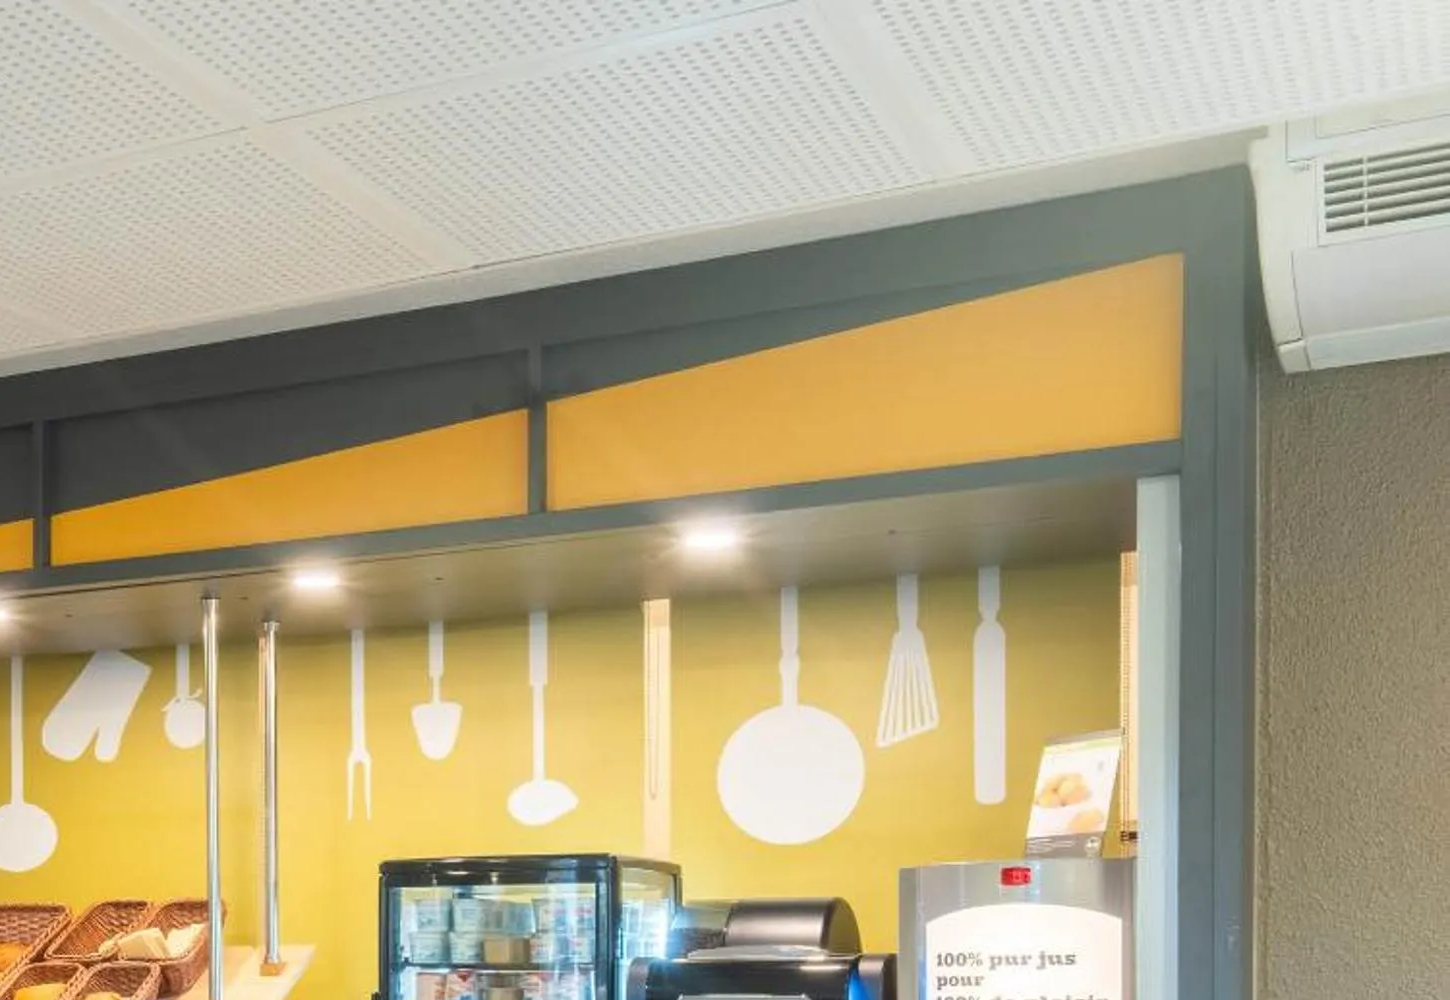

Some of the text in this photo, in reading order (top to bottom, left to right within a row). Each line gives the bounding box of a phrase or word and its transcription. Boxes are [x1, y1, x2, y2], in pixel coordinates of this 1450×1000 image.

[936, 950, 1076, 971] 100% pur jus
[937, 975, 984, 991] pour
